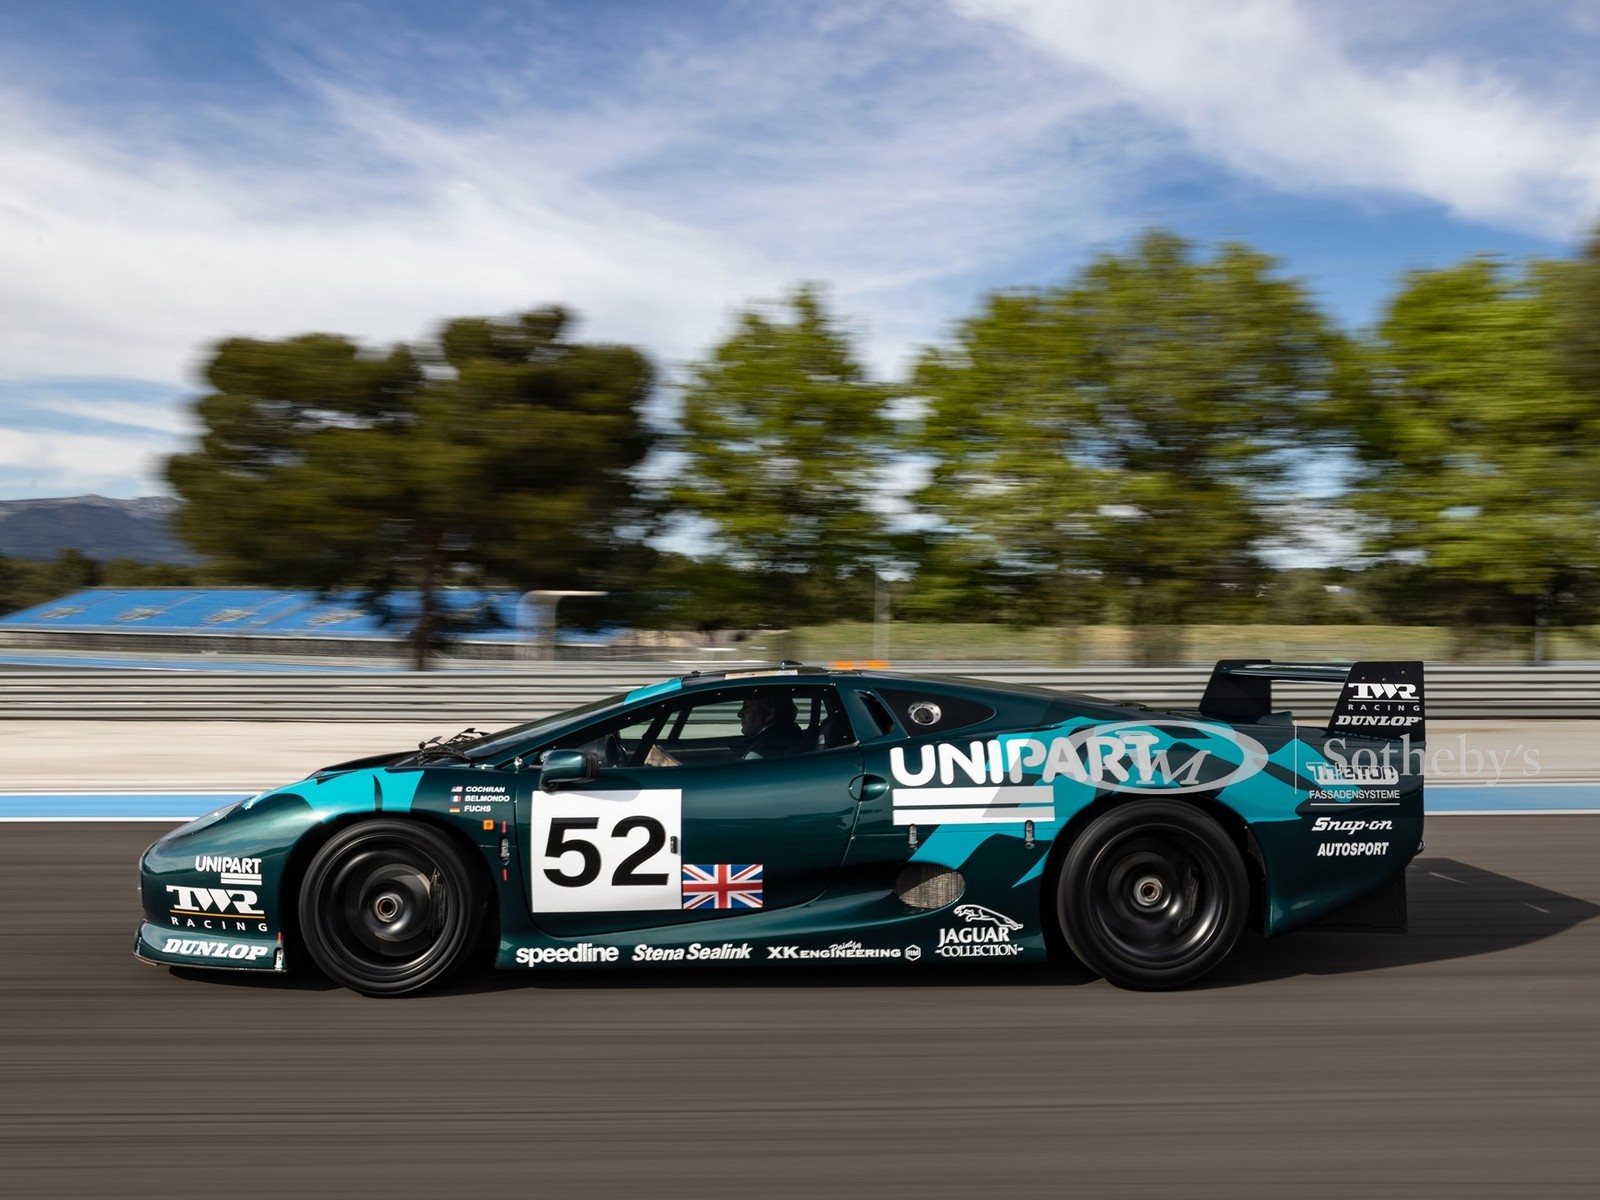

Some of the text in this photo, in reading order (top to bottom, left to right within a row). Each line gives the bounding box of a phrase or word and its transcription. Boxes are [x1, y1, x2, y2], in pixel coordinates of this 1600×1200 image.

[1348, 683, 1420, 700] TWR
[1335, 715, 1422, 726] DUNLOP
[890, 736, 1159, 786] UNIPART
[1309, 790, 1400, 799] FASSADENSYSTEME
[1311, 817, 1393, 835] Snap-on
[543, 815, 669, 888] 52
[1317, 842, 1389, 856] AUTOSPORT
[195, 855, 262, 874] UNIPART
[166, 885, 265, 914] TWR
[171, 916, 268, 932] RACING
[938, 926, 1010, 947] JAGUAR
[162, 938, 269, 960] DUNLOP
[516, 943, 619, 967] speedline
[632, 942, 753, 961] Stena Sealink
[766, 946, 800, 959] XK
[799, 948, 902, 959] ENGINEERING
